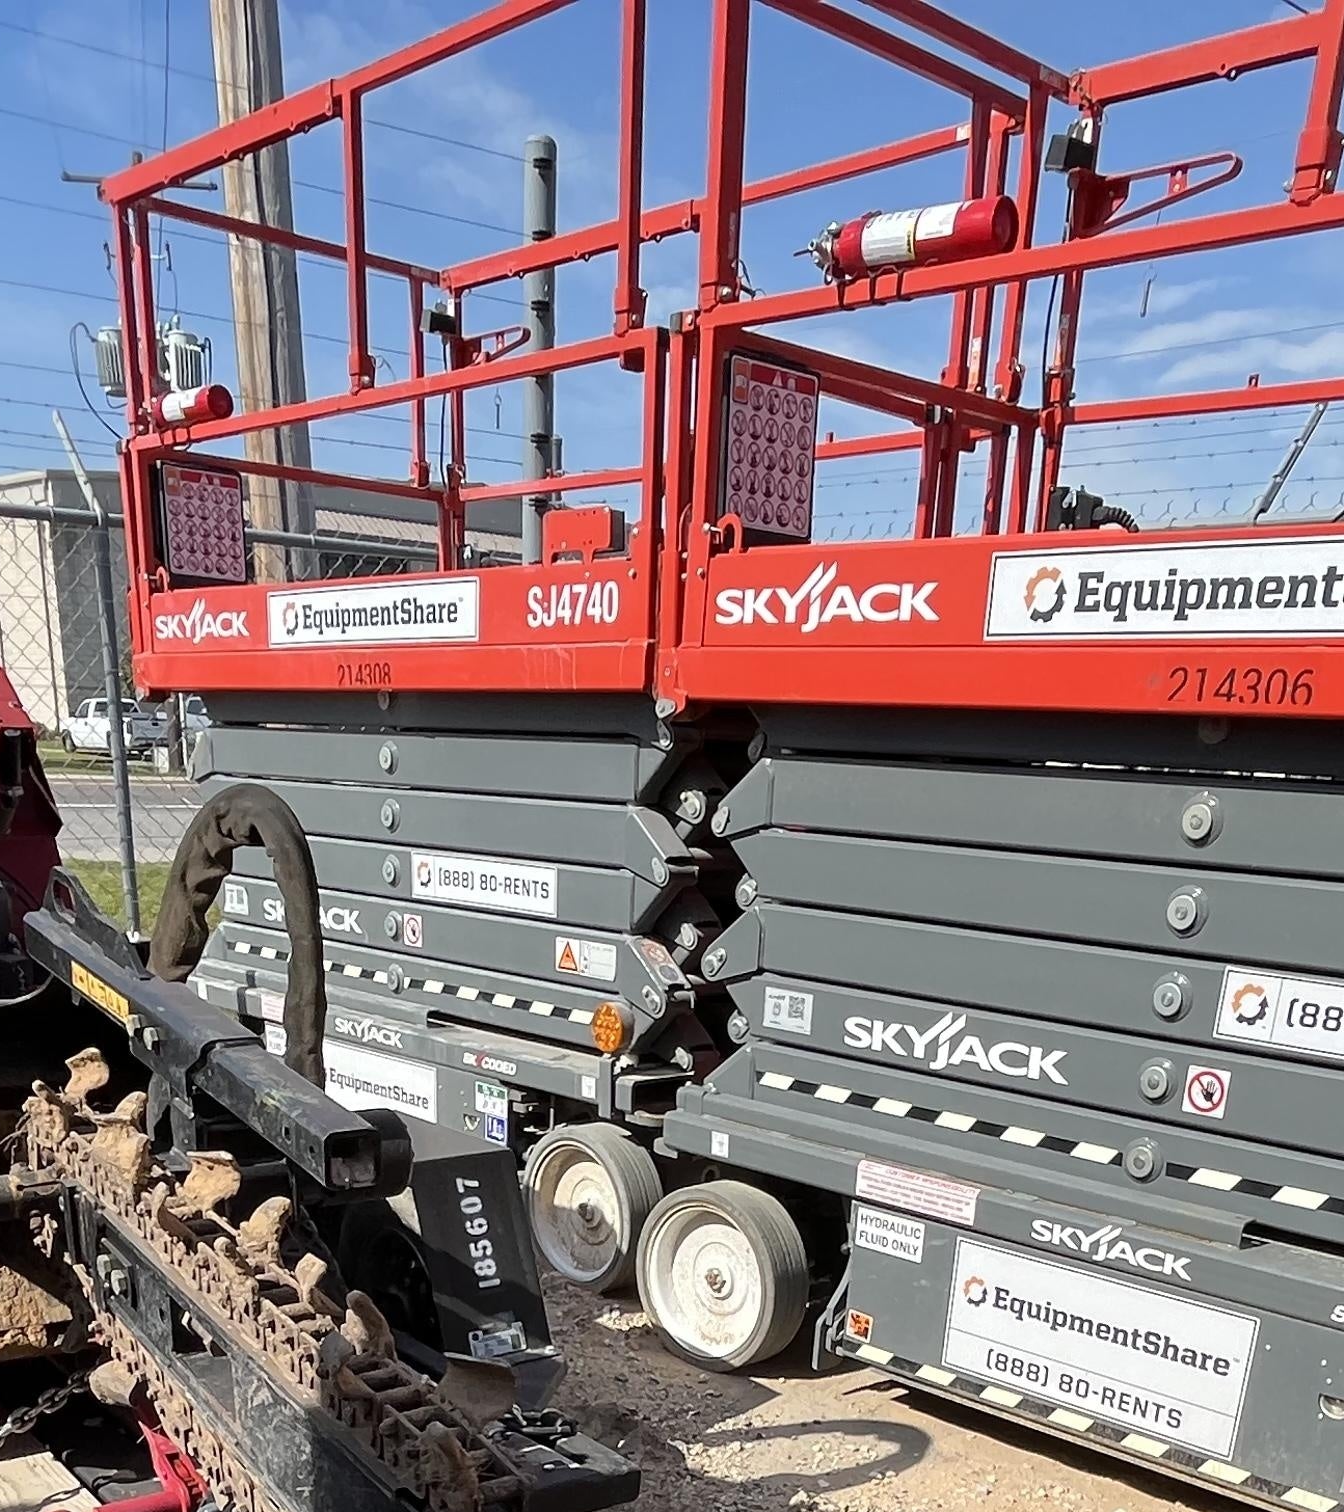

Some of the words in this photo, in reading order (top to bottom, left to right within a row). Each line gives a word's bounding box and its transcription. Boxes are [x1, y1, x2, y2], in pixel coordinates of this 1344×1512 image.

[302, 597, 458, 634] EquipmentShare
[526, 580, 620, 628] SJ4740
[715, 561, 940, 633] SKYJACK
[154, 598, 250, 644] SKYJACK
[337, 662, 392, 686] 214308
[1167, 665, 1315, 706] 214306
[438, 865, 475, 891] (888)
[479, 869, 550, 899] 80-RENTS
[263, 898, 363, 935] SKACK
[334, 1016, 404, 1049] SKYJACK
[843, 1011, 1070, 1085] SKYJACK
[329, 1067, 429, 1110] EquipmentShare
[456, 1177, 501, 1289] 185607
[859, 1230, 889, 1247] FLUID
[891, 1239, 919, 1256] ONLY
[860, 1213, 921, 1239] HYDRAULIC
[1030, 1217, 1192, 1282] SKYJACK
[992, 1286, 1231, 1377] EquipmentShare
[986, 1348, 1049, 1387] (888)
[1058, 1373, 1184, 1431] 80-RENTS
